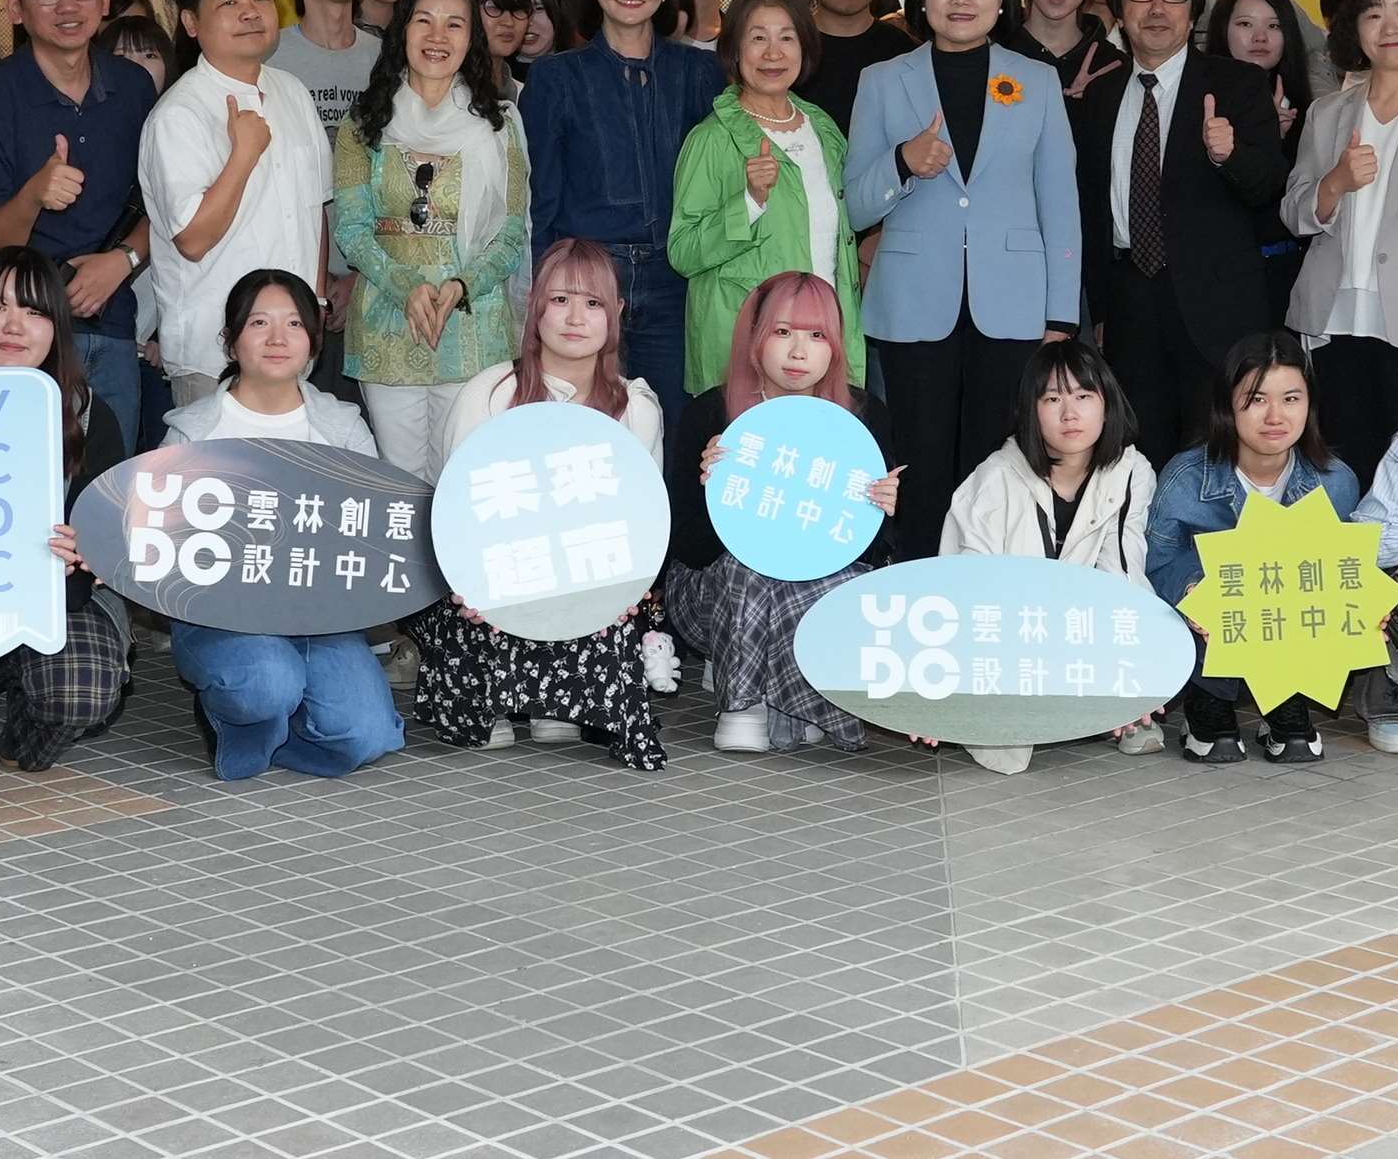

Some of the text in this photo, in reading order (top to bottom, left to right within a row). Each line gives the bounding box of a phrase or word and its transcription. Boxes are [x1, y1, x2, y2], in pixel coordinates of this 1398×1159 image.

[318, 85, 338, 102] real
[469, 442, 620, 523] 未來
[736, 431, 874, 502] 雲林創意
[247, 490, 417, 542] 雲林創意
[721, 474, 855, 544] 設計中心
[242, 544, 412, 595] 設計中心
[1219, 556, 1364, 599] 雲林創意
[971, 604, 1142, 647] 雲林創意
[1221, 603, 1367, 646] 設計中心
[971, 656, 1142, 698] 設計中心
